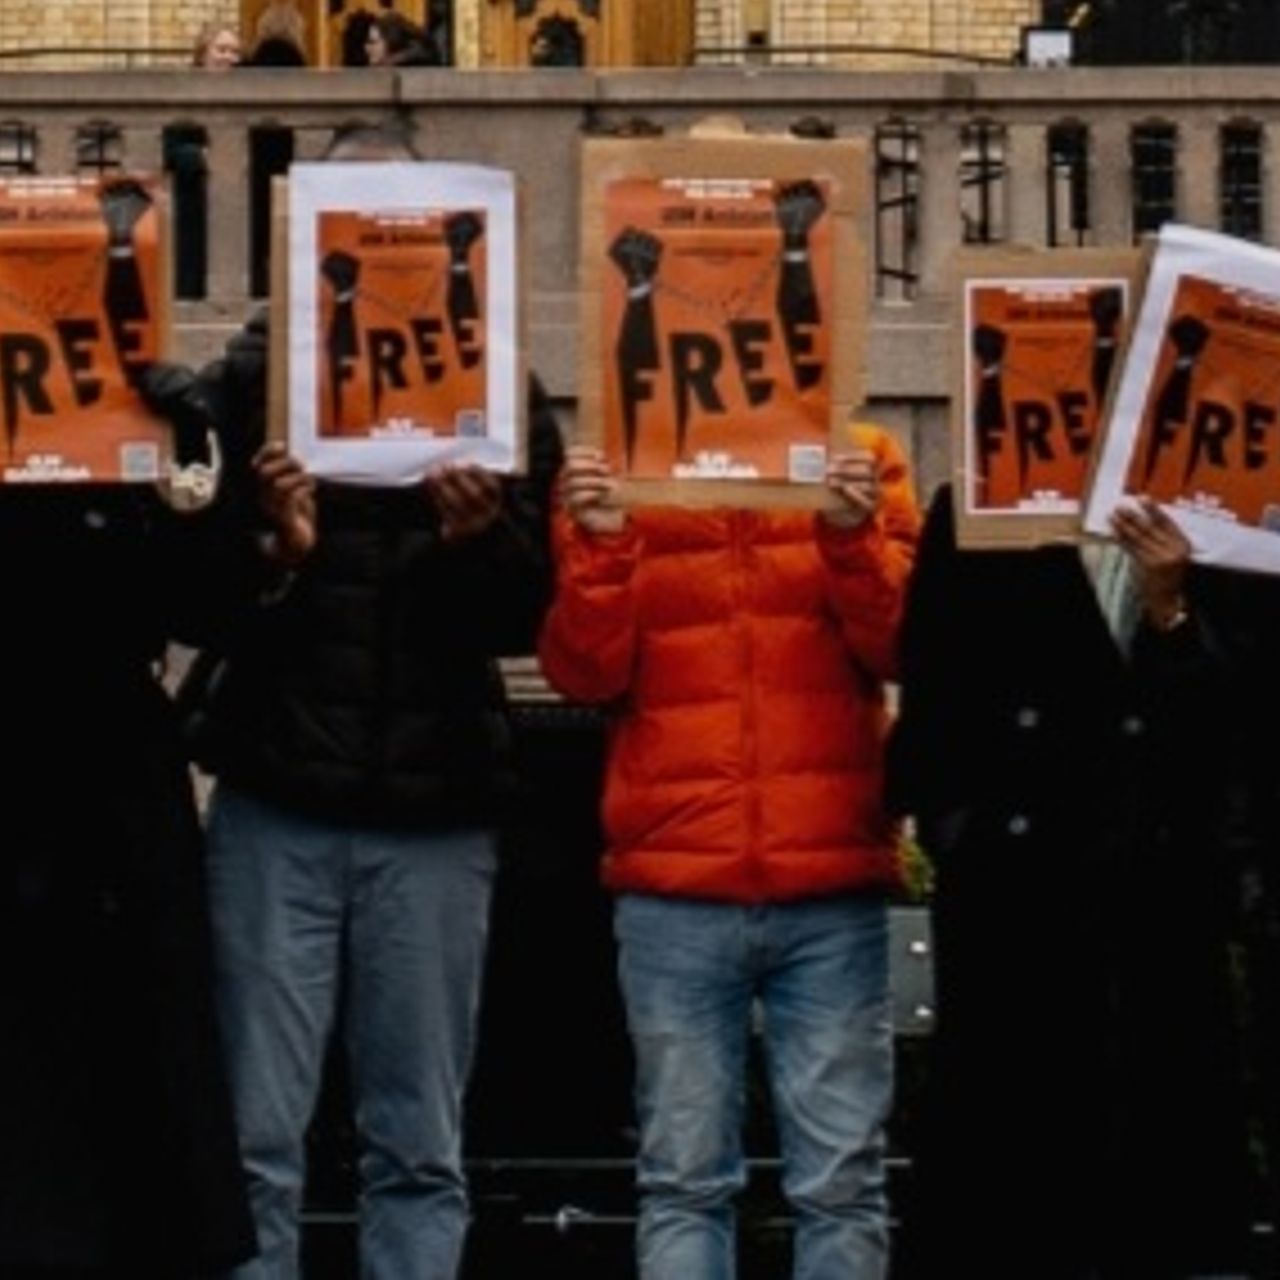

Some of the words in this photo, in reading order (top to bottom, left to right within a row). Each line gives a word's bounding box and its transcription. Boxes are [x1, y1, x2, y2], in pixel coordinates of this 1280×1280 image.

[328, 308, 482, 436] FREE
[617, 306, 824, 472] FREE
[975, 385, 1104, 506] FRE
